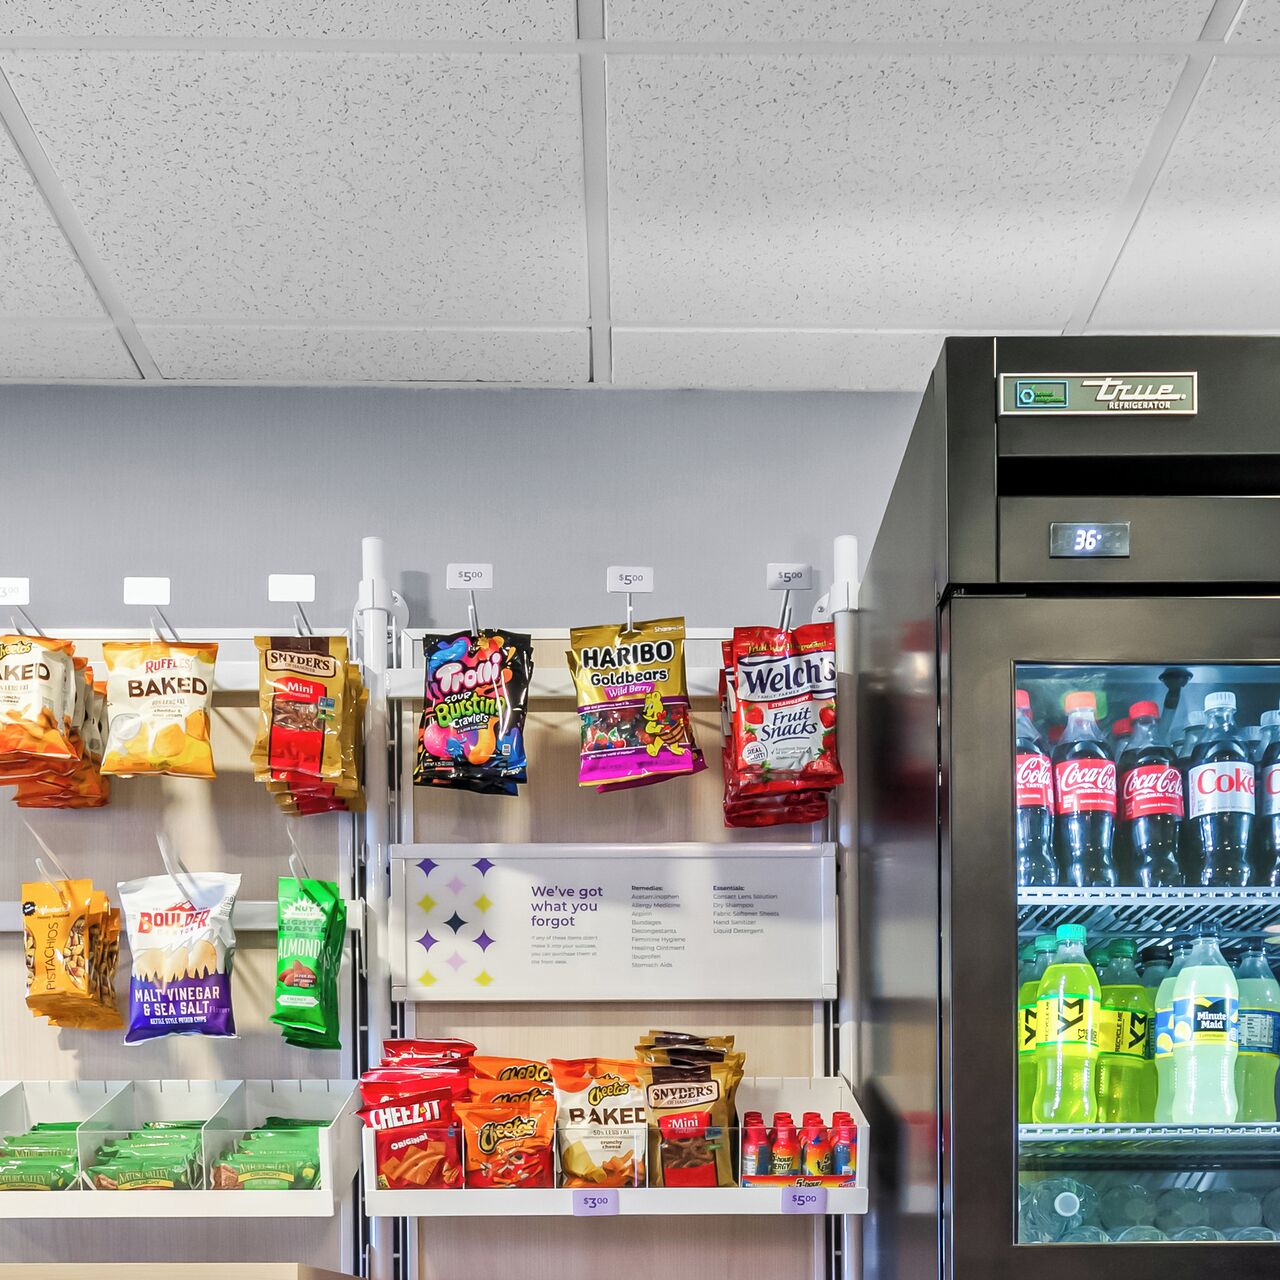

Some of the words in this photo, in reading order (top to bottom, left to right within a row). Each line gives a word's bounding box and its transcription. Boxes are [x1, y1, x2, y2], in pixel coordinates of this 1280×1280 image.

[1108, 401, 1171, 409] REFRIGERATOR
[270, 652, 331, 671] SNYDER'S
[582, 640, 675, 670] HARIBO
[436, 652, 502, 693] Trolli
[590, 668, 668, 687] Goldbears
[742, 658, 836, 694] Welch's
[127, 677, 208, 698] BAKED
[288, 681, 314, 694] Mini
[608, 686, 627, 698] Wild
[629, 684, 652, 696] Berry
[445, 691, 472, 704] SOUR
[771, 695, 810, 709] STRAWBERRY
[435, 693, 508, 728] Bursting
[772, 707, 812, 727] Fruit
[453, 713, 489, 729] Crawlers
[760, 720, 819, 742] Snacks
[531, 885, 575, 897] We've
[579, 886, 603, 899] got
[531, 900, 568, 912] what
[571, 902, 598, 914] you
[138, 908, 211, 934] BOULDER
[531, 915, 576, 929] forgot
[43, 921, 59, 990] PISTACHIOS
[134, 988, 162, 1002] MALT
[166, 985, 220, 1001] VINEGAR
[143, 1003, 150, 1016] &
[154, 1002, 176, 1016] SEA
[180, 1001, 210, 1015] SALT
[1197, 1011, 1227, 1021] Minute
[1201, 1020, 1223, 1029] Maid
[1114, 1022, 1122, 1052] RECYCLE
[587, 1080, 630, 1107] Cheetos
[652, 1083, 714, 1103] SNYDER'S
[568, 1106, 647, 1125] BAKED
[671, 1115, 699, 1129] Mini
[390, 1132, 428, 1151] ORIGINAL
[478, 1115, 537, 1155] Cheetos
[145, 1169, 170, 1180] VALLEY
